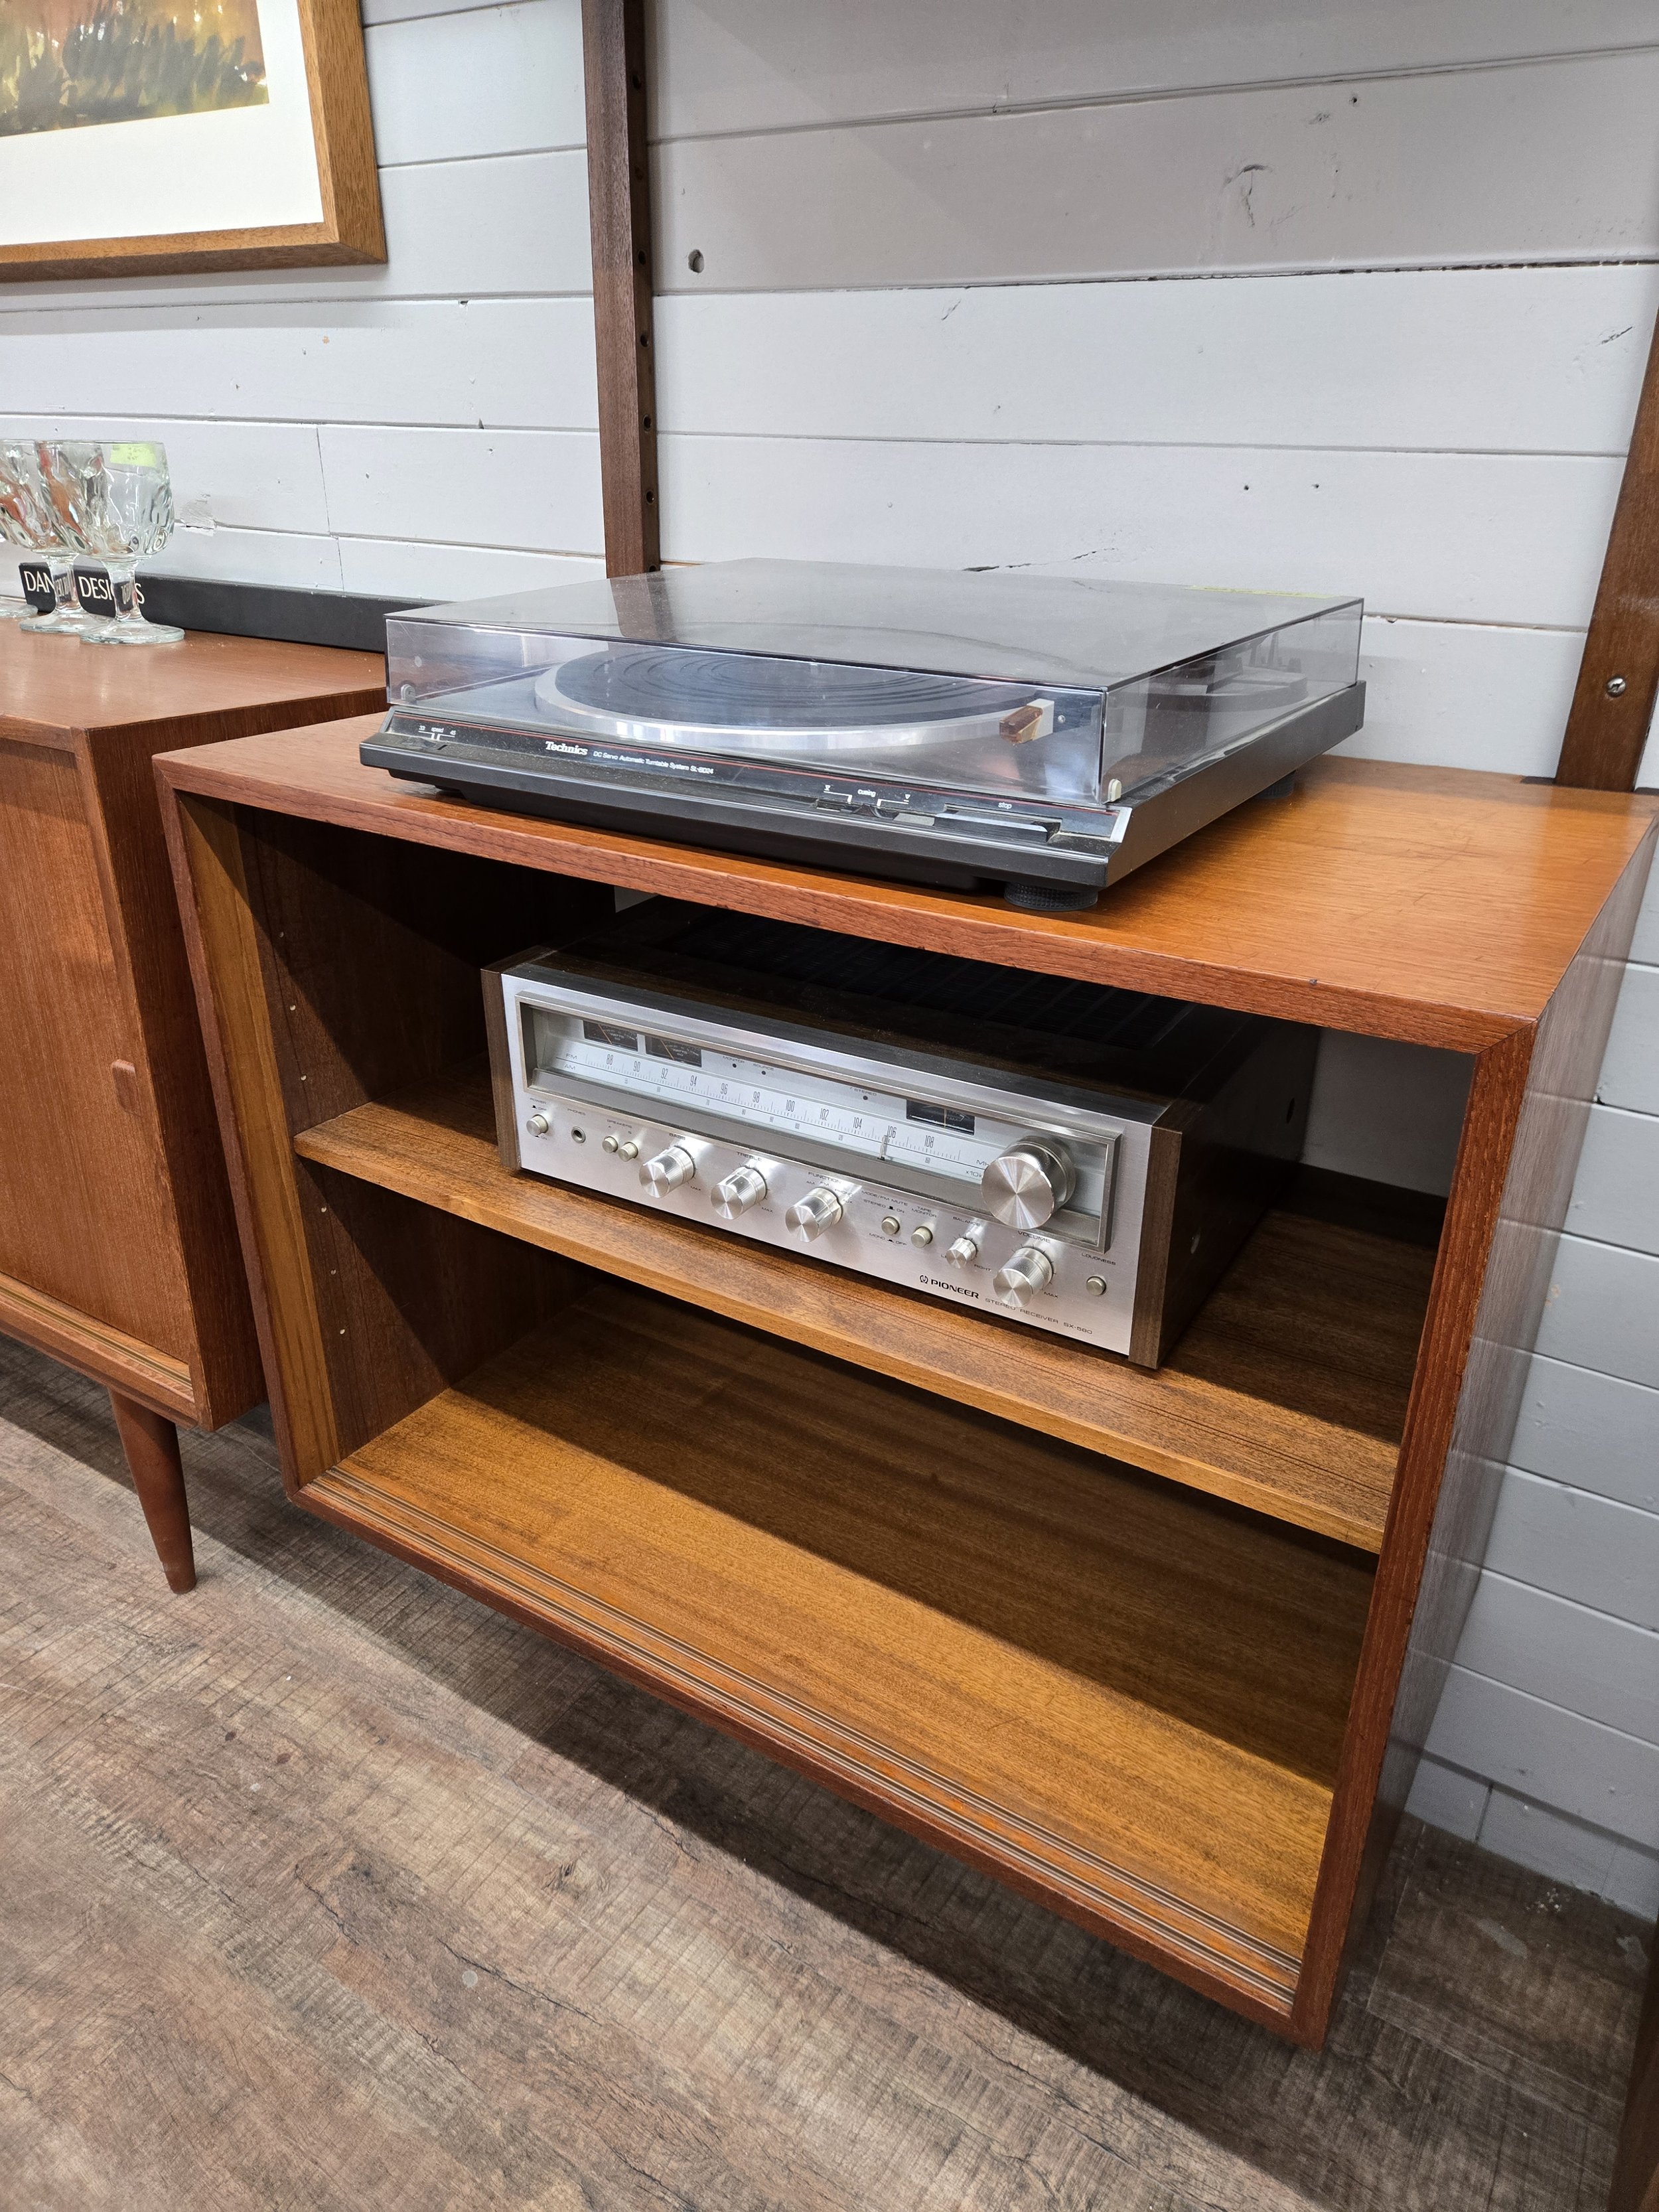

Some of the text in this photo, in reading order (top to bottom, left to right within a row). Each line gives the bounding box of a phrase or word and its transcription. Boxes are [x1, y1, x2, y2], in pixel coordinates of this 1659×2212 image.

[24, 570, 56, 593] DAN
[78, 576, 145, 604] DESIS
[545, 741, 588, 755] Technics
[618, 755, 644, 764] Automatic
[646, 759, 669, 768] Turntable
[670, 762, 689, 771] System
[606, 1054, 613, 1065] 88
[633, 1061, 640, 1072] 90
[660, 1068, 668, 1079] 92
[689, 1075, 697, 1086] 94
[720, 1083, 729, 1094] 96
[753, 1091, 760, 1103] 98
[786, 1099, 795, 1112] 100
[820, 1108, 829, 1120] 102
[853, 1117, 862, 1129] 104
[887, 1126, 897, 1138] 106
[924, 1135, 934, 1148] 108
[737, 1152, 762, 1161] TREBLE
[808, 1171, 842, 1185] FUNCTION
[861, 1191, 890, 1201] MODE/FM
[864, 1199, 886, 1208] STEREO
[911, 1209, 937, 1218] MONITOR
[953, 1216, 980, 1227] BALANCE
[1018, 1230, 1051, 1243] VOLUME
[1082, 1252, 1116, 1266] LOUDNESS
[931, 1278, 1094, 1335] PIONEER STEREO RECEIVER SX-580
